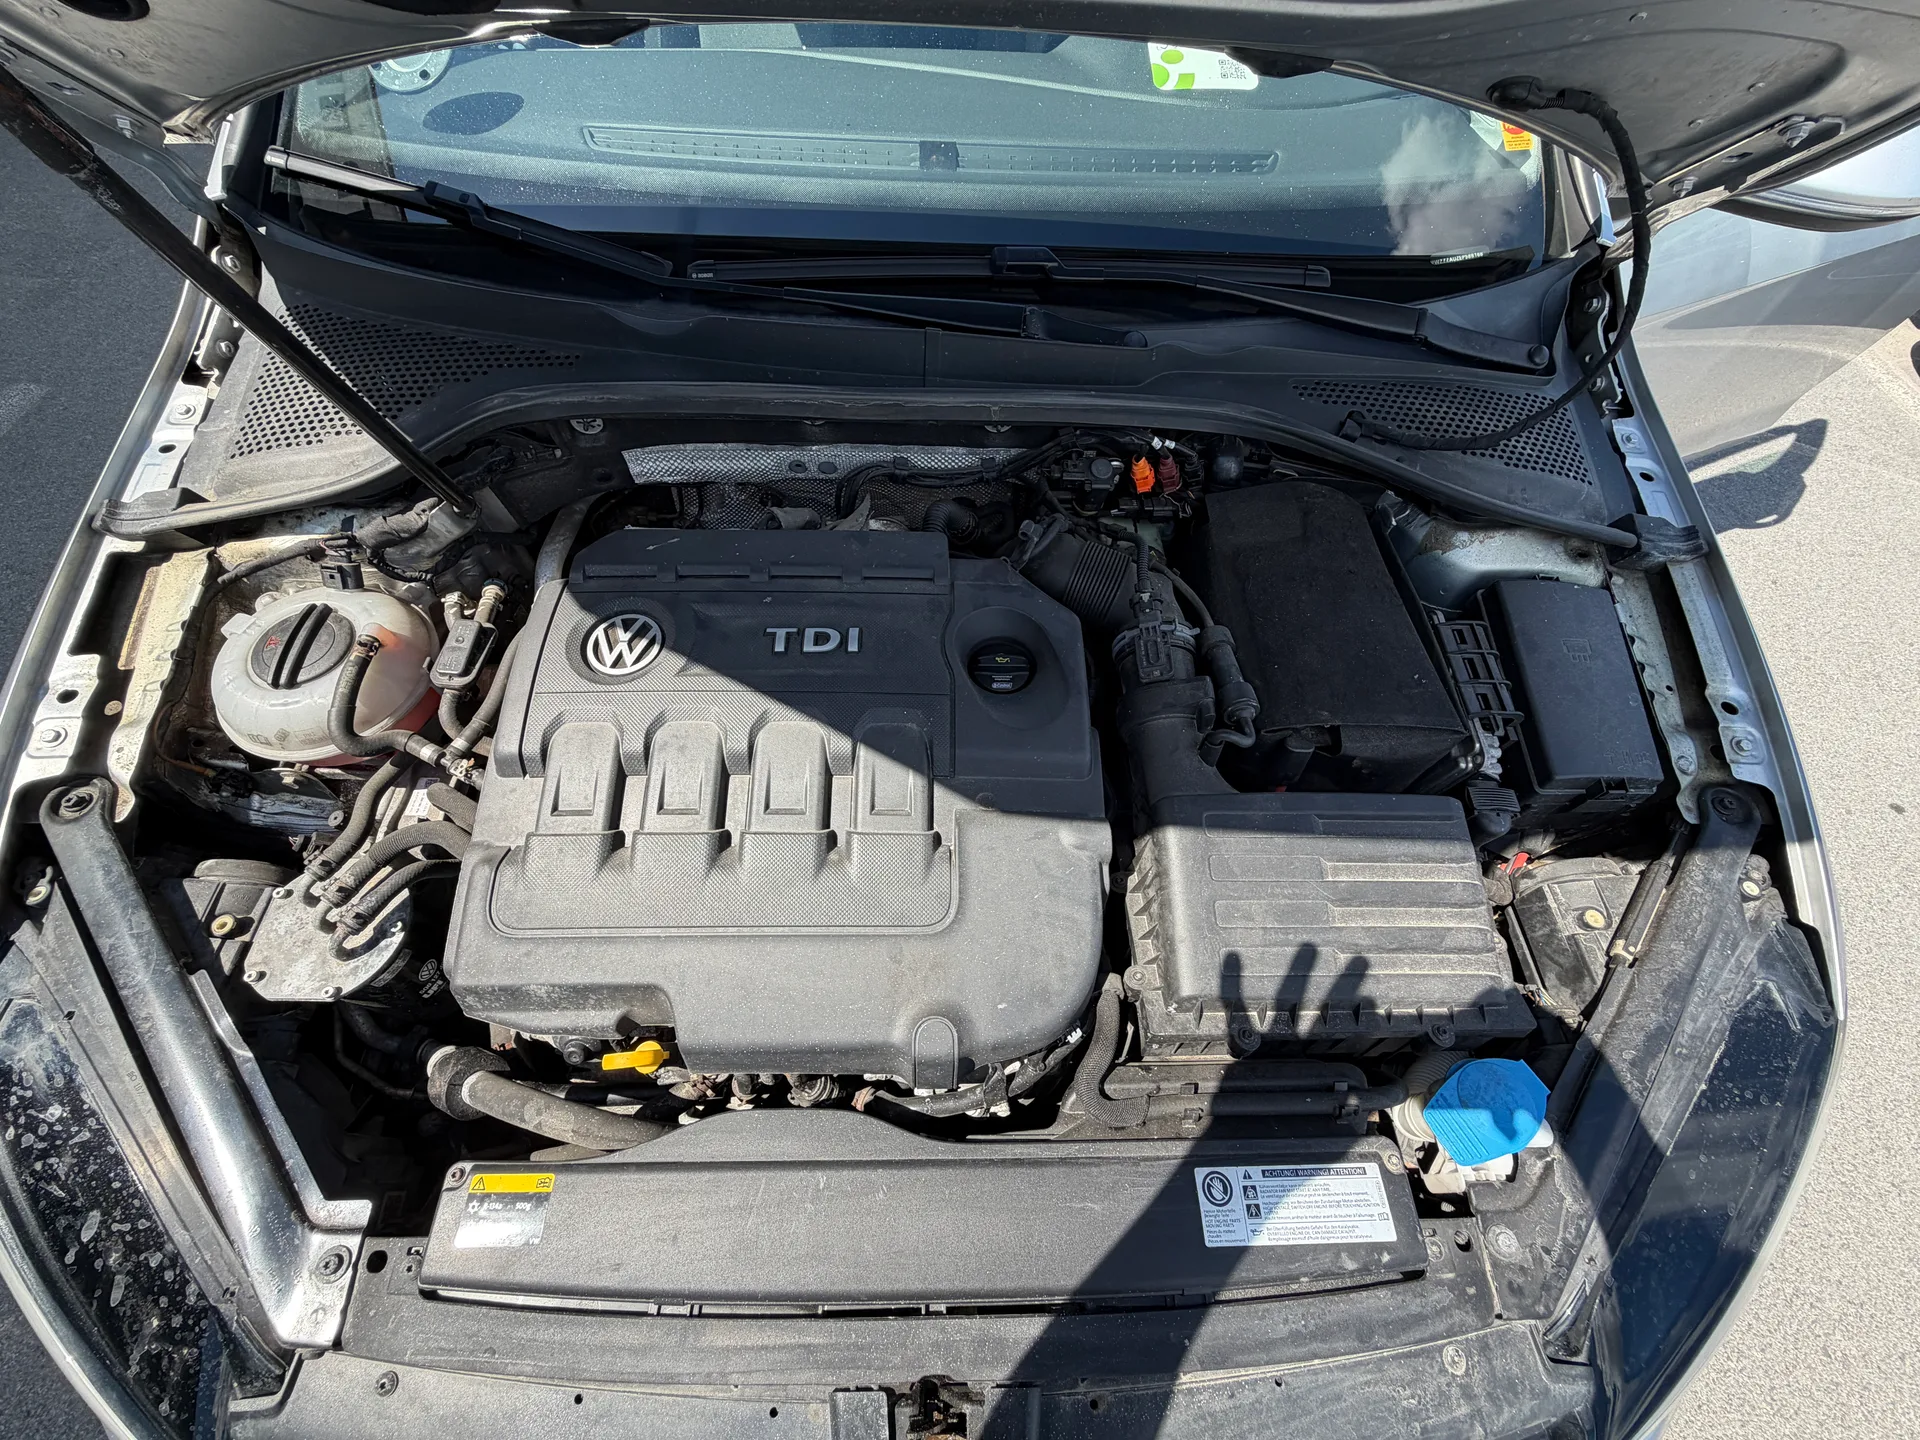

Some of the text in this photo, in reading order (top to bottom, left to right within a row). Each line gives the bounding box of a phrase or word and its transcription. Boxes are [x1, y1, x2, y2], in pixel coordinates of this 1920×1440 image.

[766, 627, 861, 652] TDI
[422, 980, 444, 998] UFI
[515, 1202, 532, 1211] 500g
